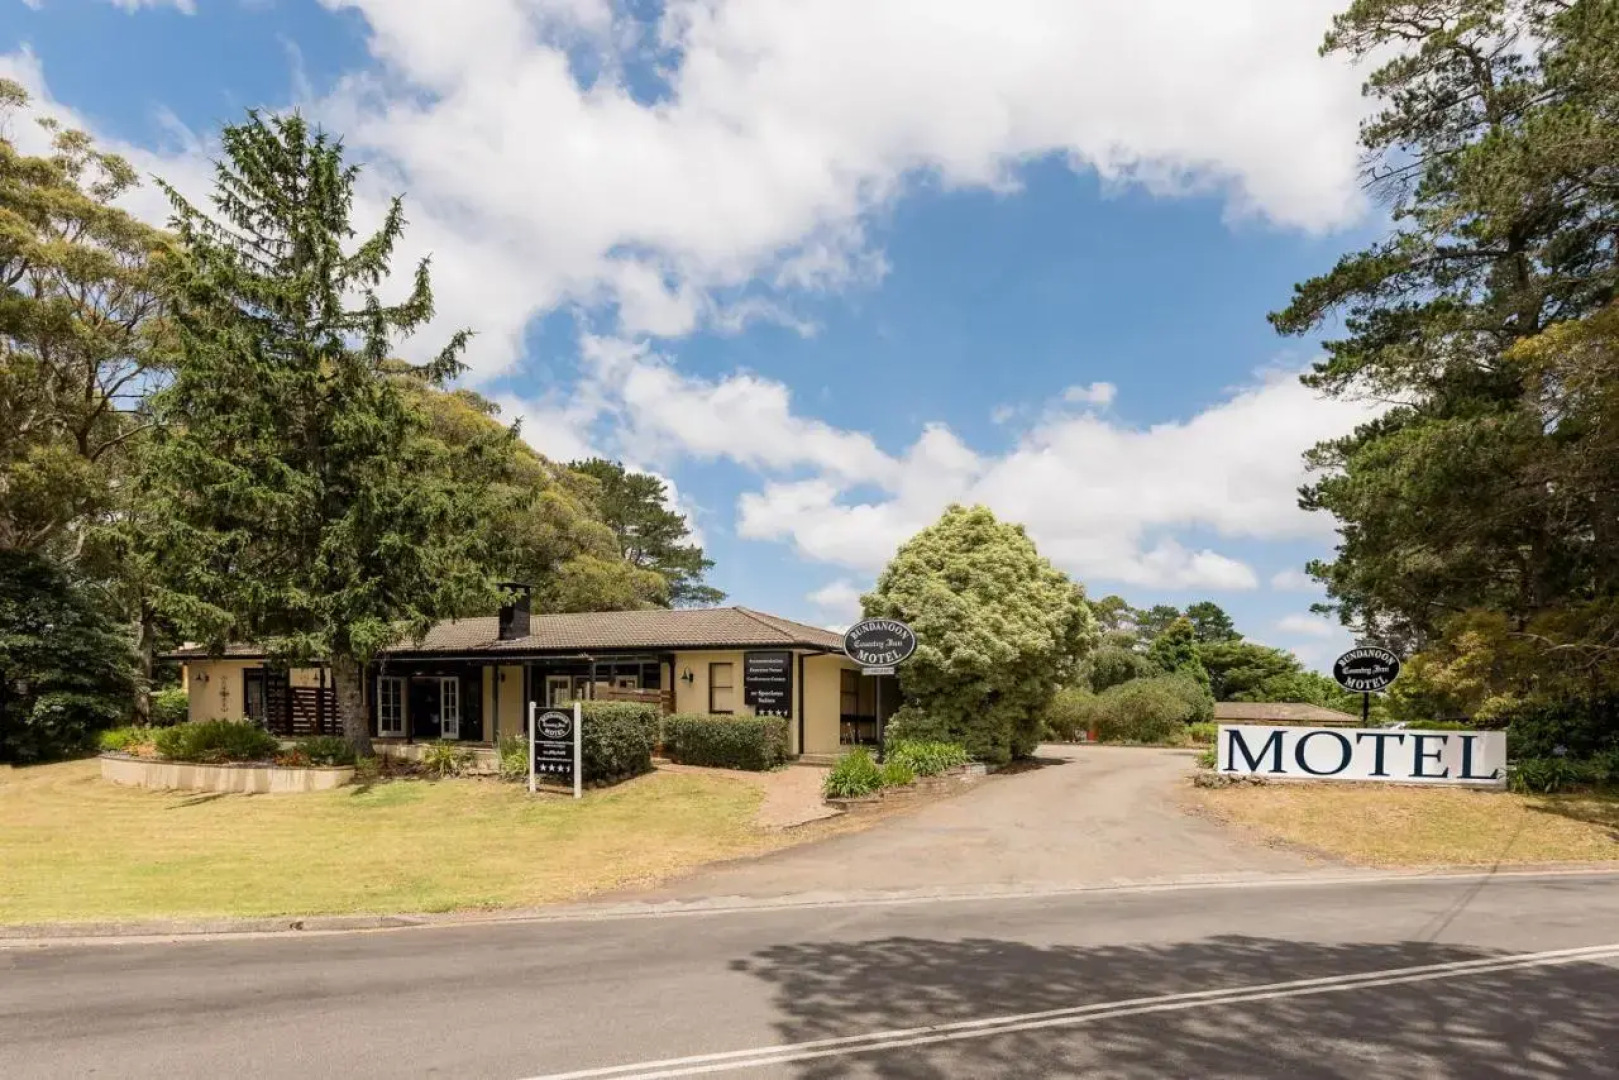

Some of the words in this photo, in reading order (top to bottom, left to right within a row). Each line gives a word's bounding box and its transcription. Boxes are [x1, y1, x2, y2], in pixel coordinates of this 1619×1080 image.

[850, 621, 909, 640] BUNDANOON
[858, 649, 902, 664] MOTEL
[1338, 649, 1396, 668] BUNDANOON
[1344, 676, 1388, 690] MOTEL
[1222, 728, 1500, 780] MOTEL
